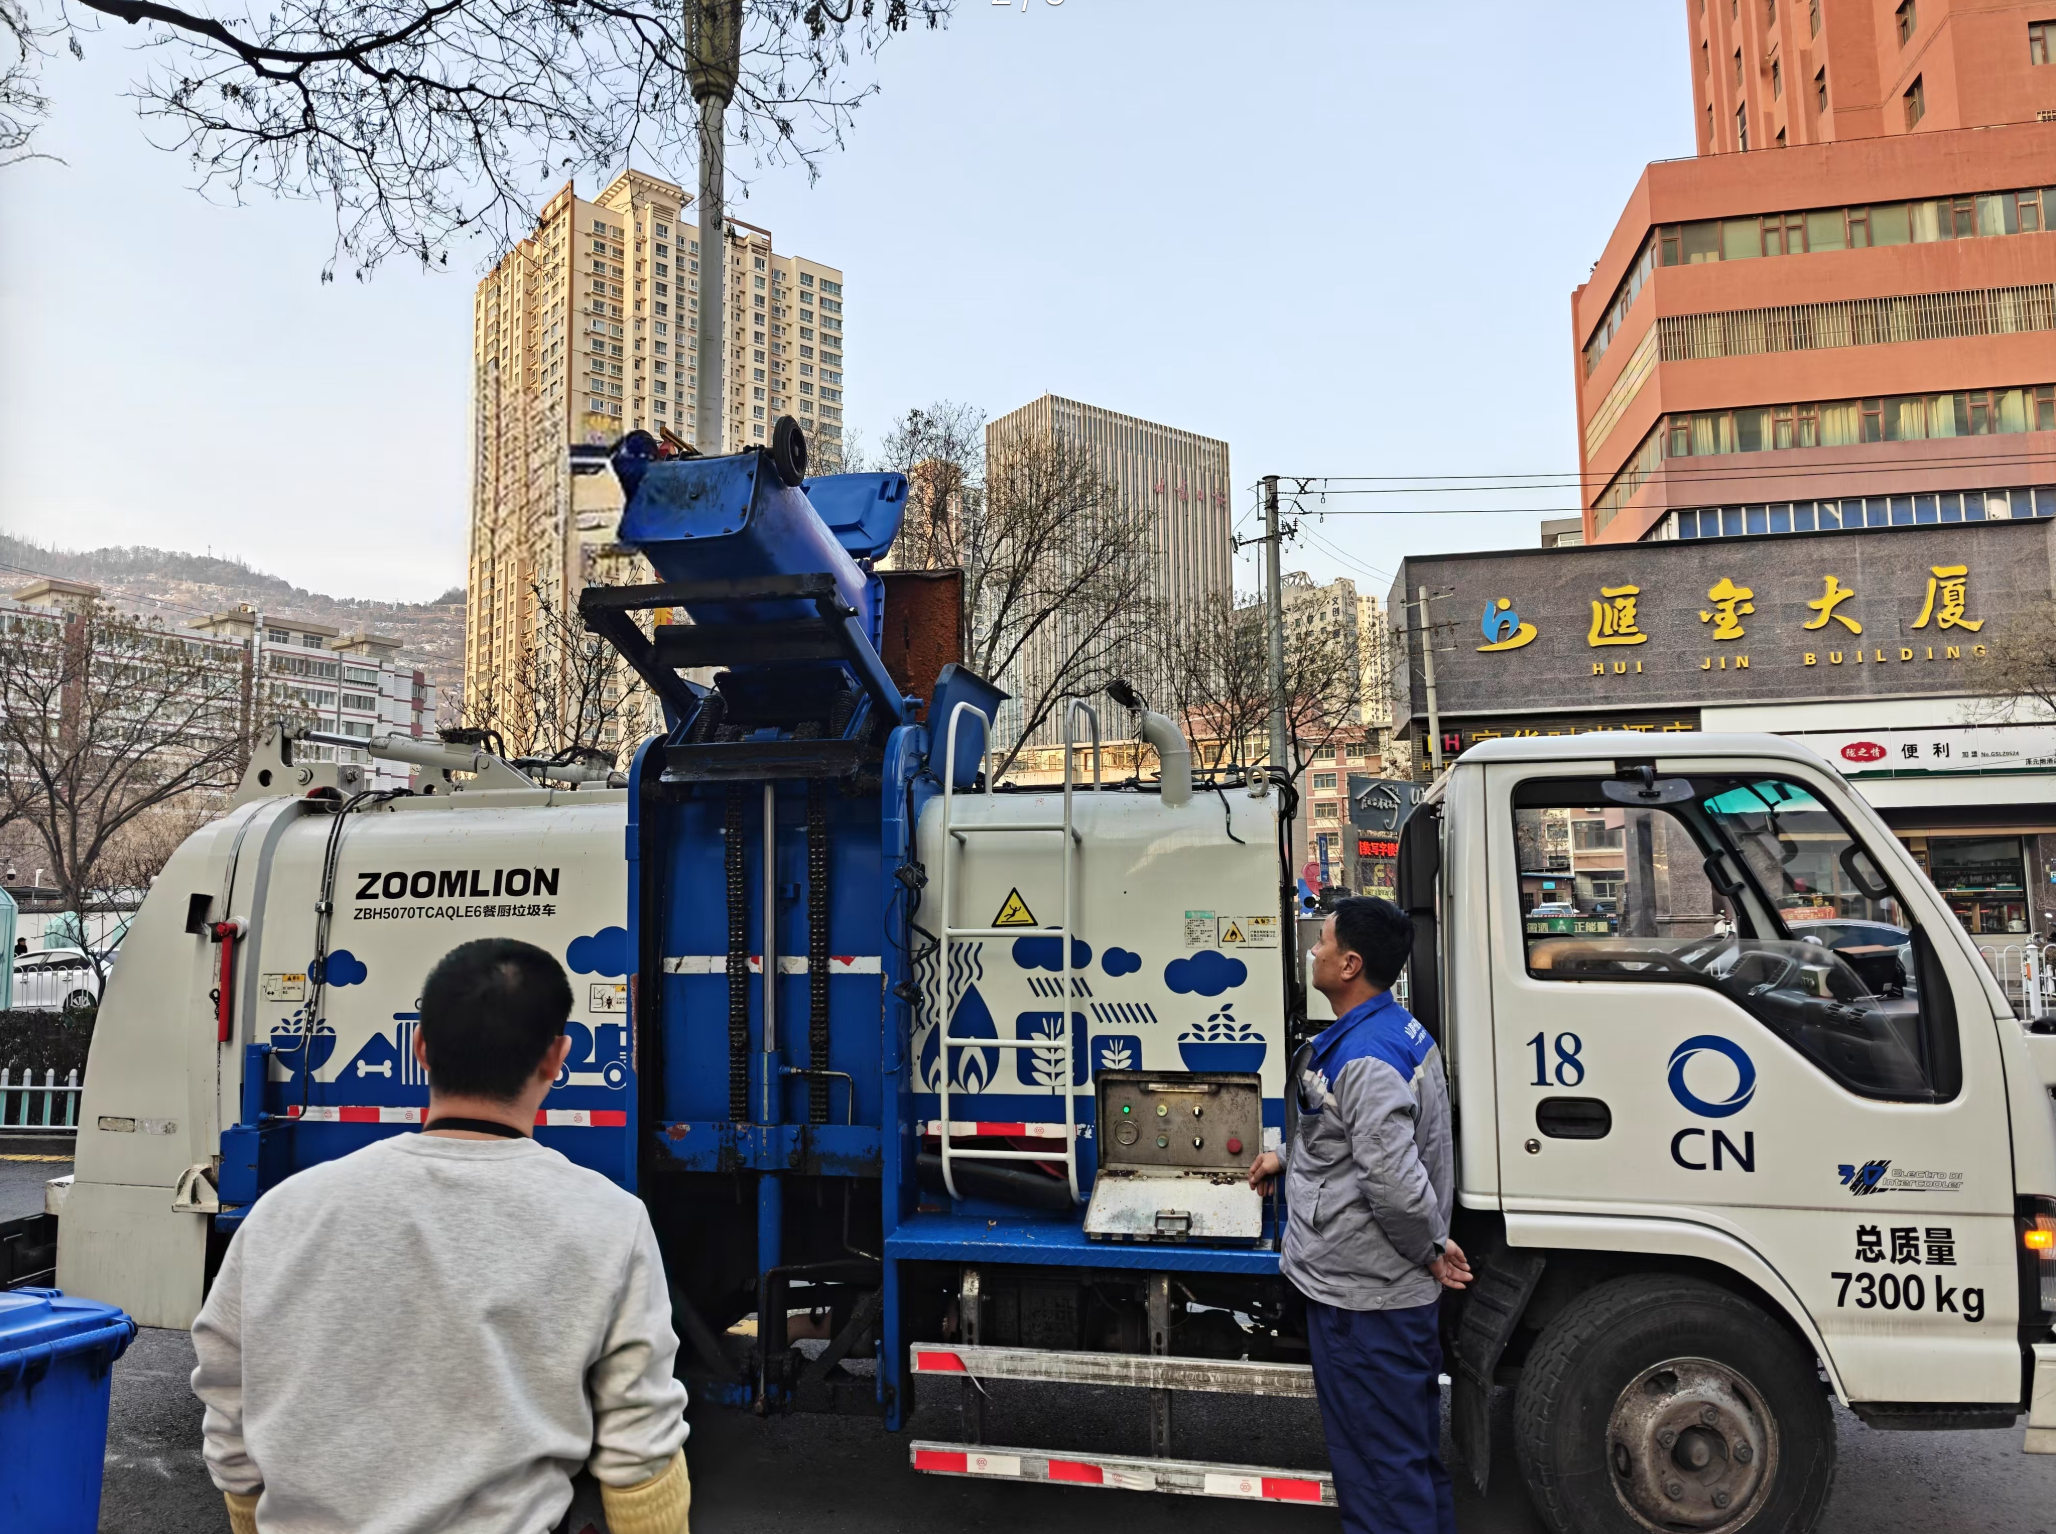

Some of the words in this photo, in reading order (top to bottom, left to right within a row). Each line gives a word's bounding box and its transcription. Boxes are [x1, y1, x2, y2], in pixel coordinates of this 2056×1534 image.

[1592, 660, 1643, 676] HUI
[1700, 655, 1750, 671] JIN
[1804, 644, 1987, 666] BUILDING
[1901, 742, 1950, 759] 便利
[355, 867, 561, 900] ZOOMLION
[1574, 921, 1609, 933] 正能量
[1526, 1031, 1586, 1087] 18
[1670, 1128, 1756, 1173] CN
[1854, 1223, 1958, 1267] 总质量
